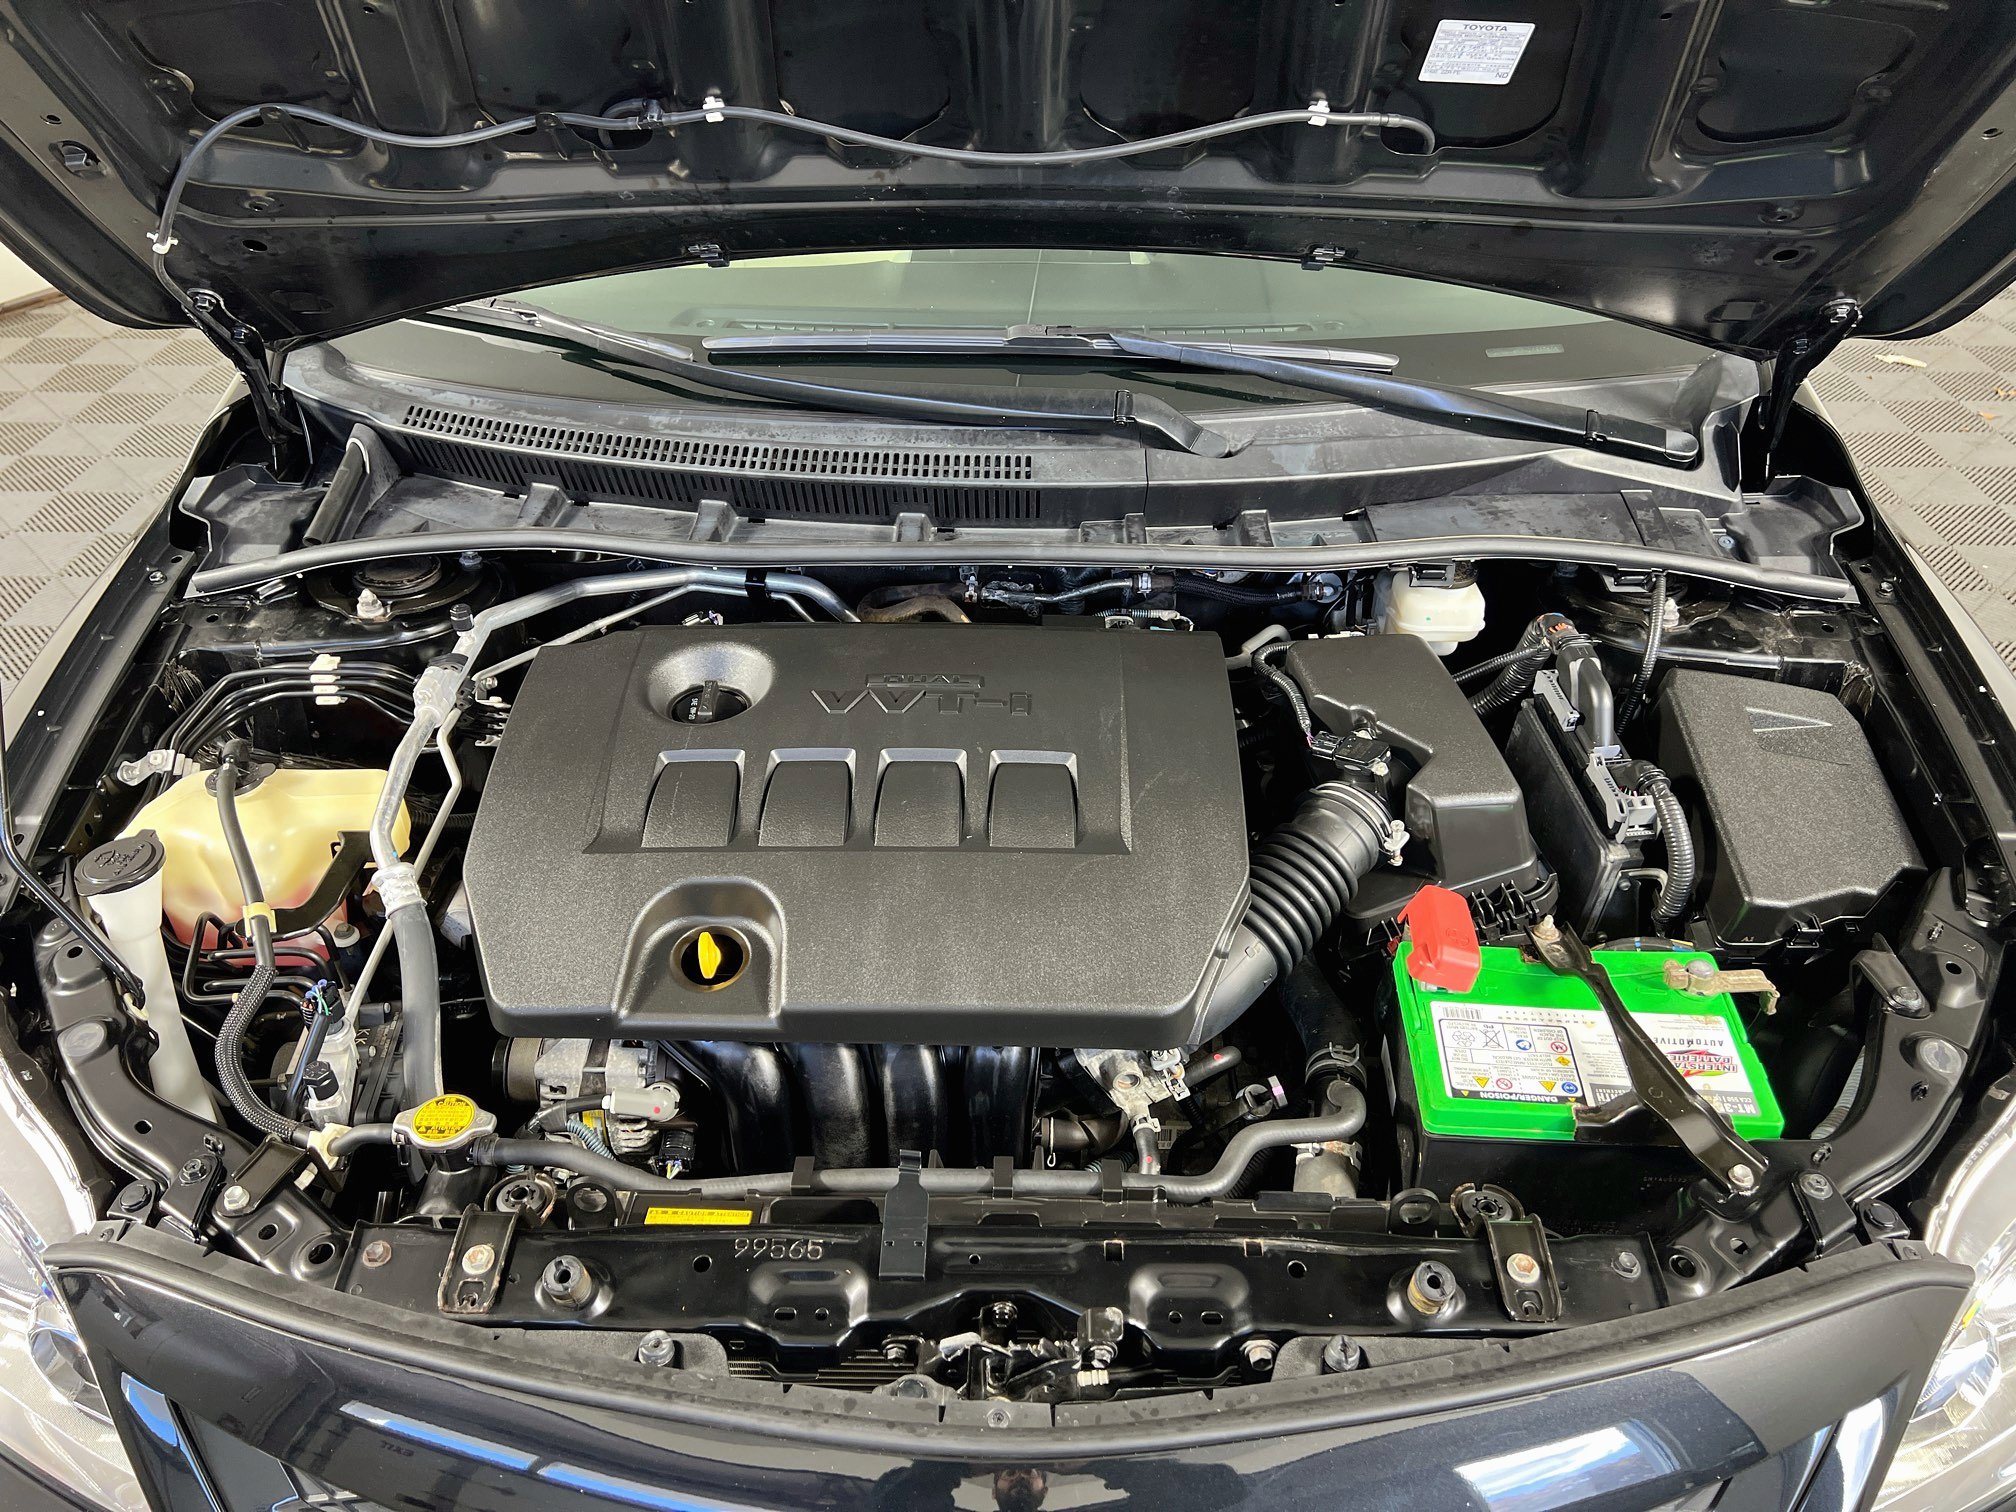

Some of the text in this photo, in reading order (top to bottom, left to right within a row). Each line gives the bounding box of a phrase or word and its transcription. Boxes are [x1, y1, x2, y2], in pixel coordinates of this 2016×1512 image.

[1463, 24, 1508, 32] TOYOTA
[689, 706, 697, 720] 0W-20
[1653, 1037, 1724, 1047] AUTOMOTIVE
[1666, 1055, 1730, 1063] BATTERIE
[1674, 1062, 1735, 1072] INTERSTA
[1479, 1092, 1558, 1102] DANGER/POISON
[734, 1237, 824, 1260] 99565
